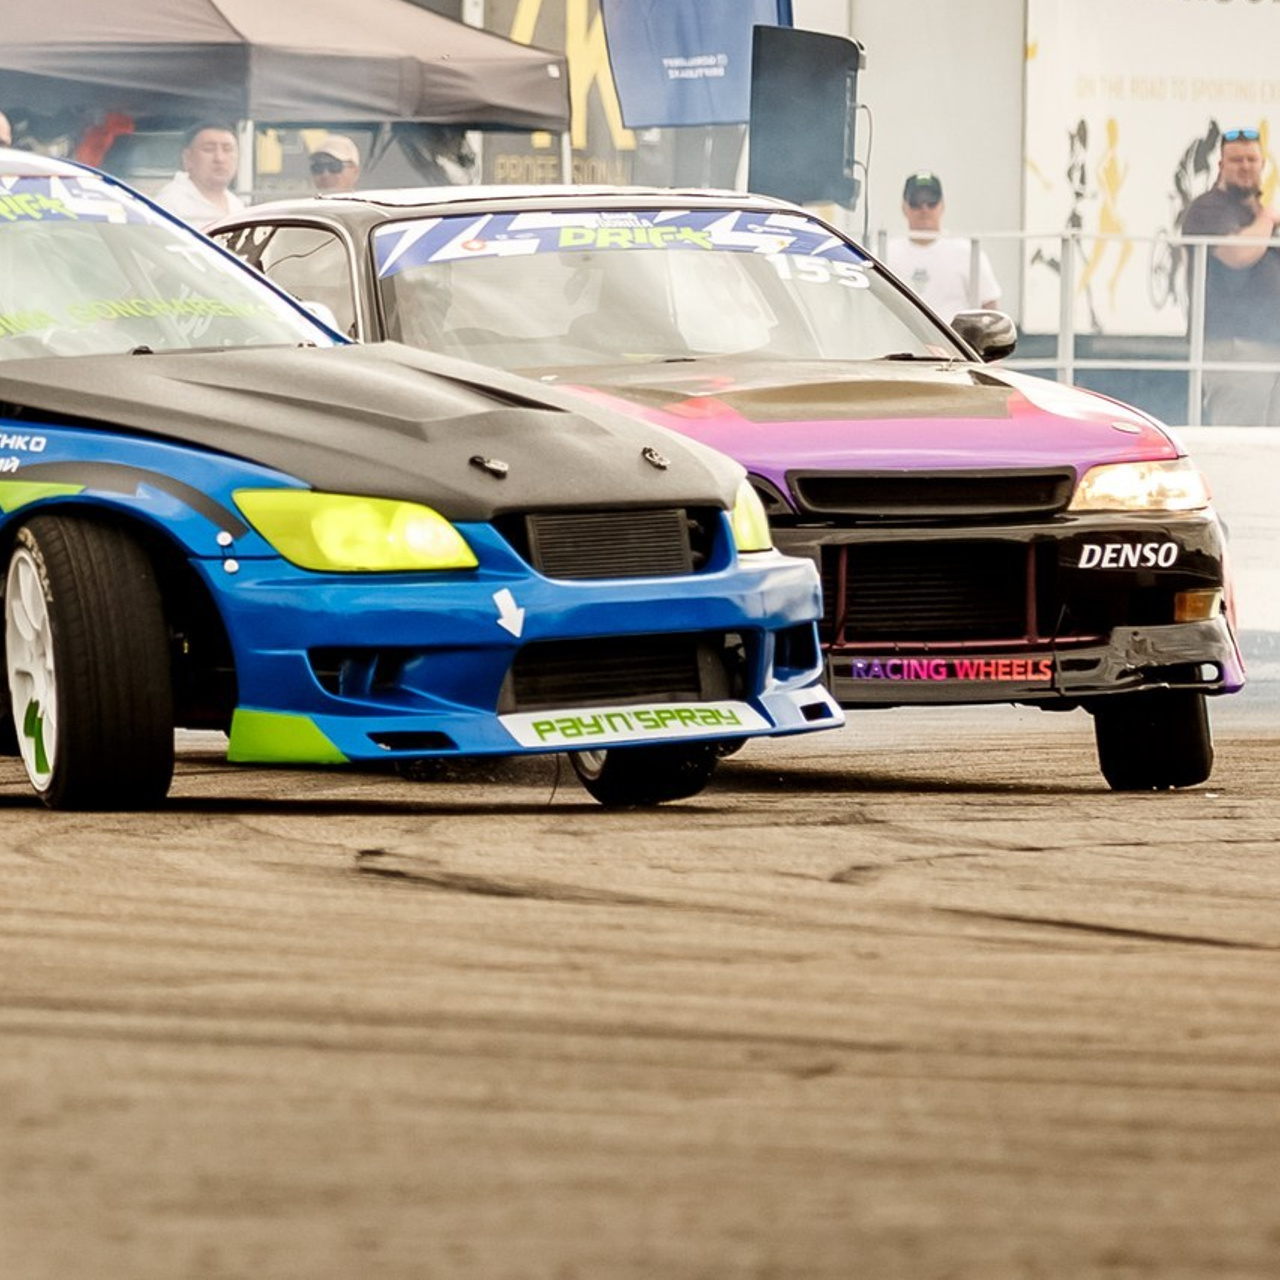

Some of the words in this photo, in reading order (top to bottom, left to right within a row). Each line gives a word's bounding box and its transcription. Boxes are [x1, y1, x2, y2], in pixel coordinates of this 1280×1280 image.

[558, 226, 716, 251] DRIFT
[764, 253, 871, 289] 155
[1077, 541, 1179, 571] DENSO
[850, 658, 948, 682] RACING
[954, 657, 1053, 682] WHEELS
